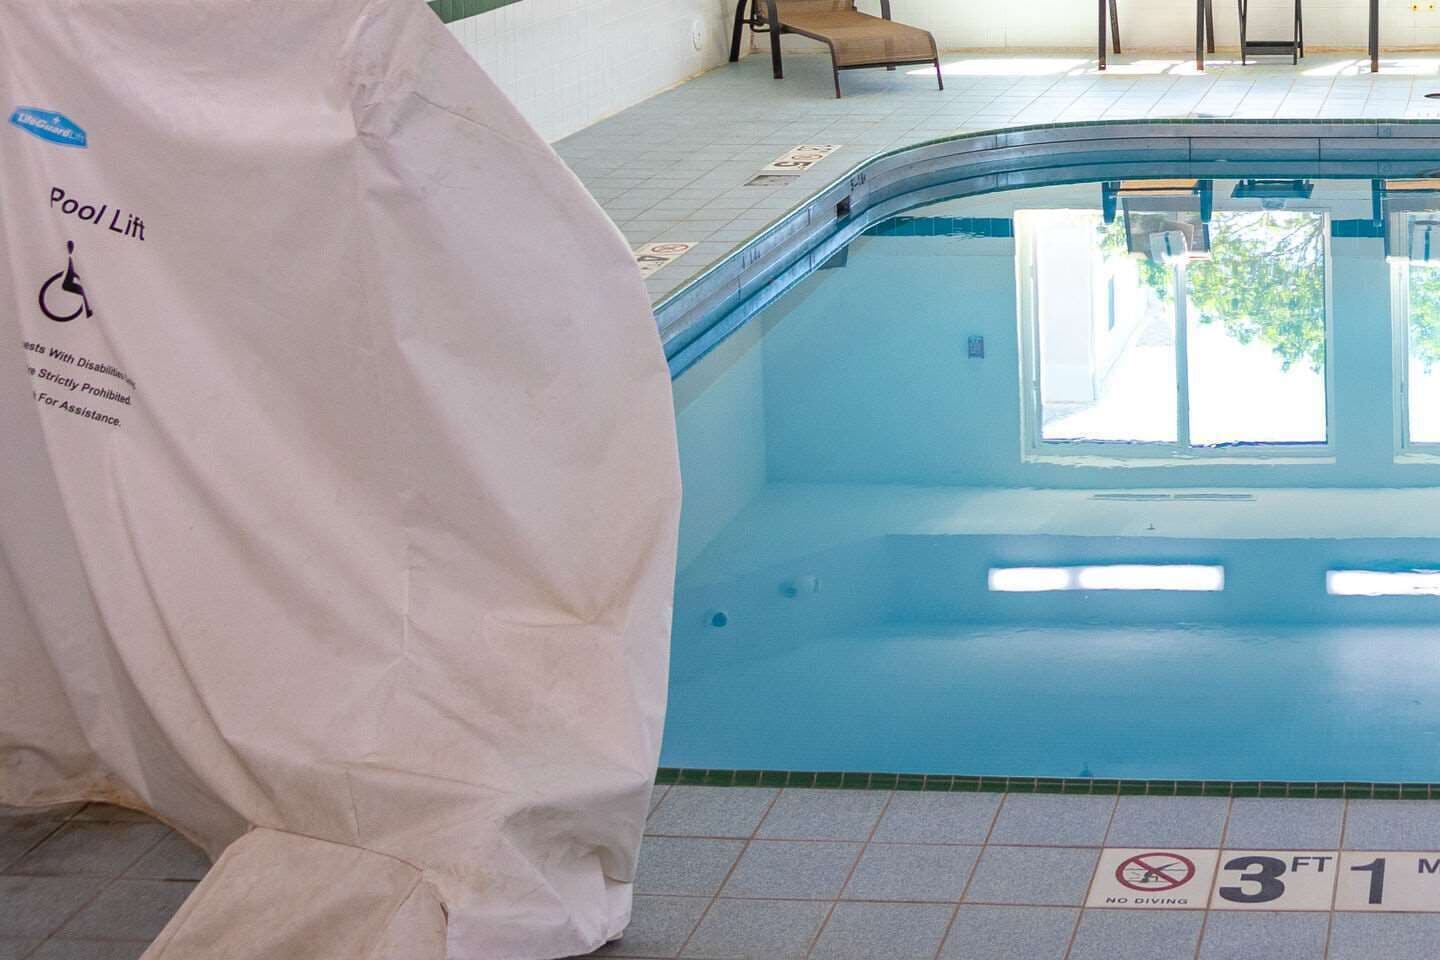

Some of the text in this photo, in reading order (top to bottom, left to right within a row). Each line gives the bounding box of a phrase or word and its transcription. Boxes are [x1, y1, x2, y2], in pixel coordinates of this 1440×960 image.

[50, 187, 144, 241] Pool Lift
[48, 347, 74, 365] With
[38, 368, 79, 391] Strictly
[38, 393, 59, 407] For
[1219, 855, 1287, 904] 3
[1291, 856, 1333, 873] FT
[1350, 857, 1386, 905] 1
[1134, 897, 1188, 905] DIVING
